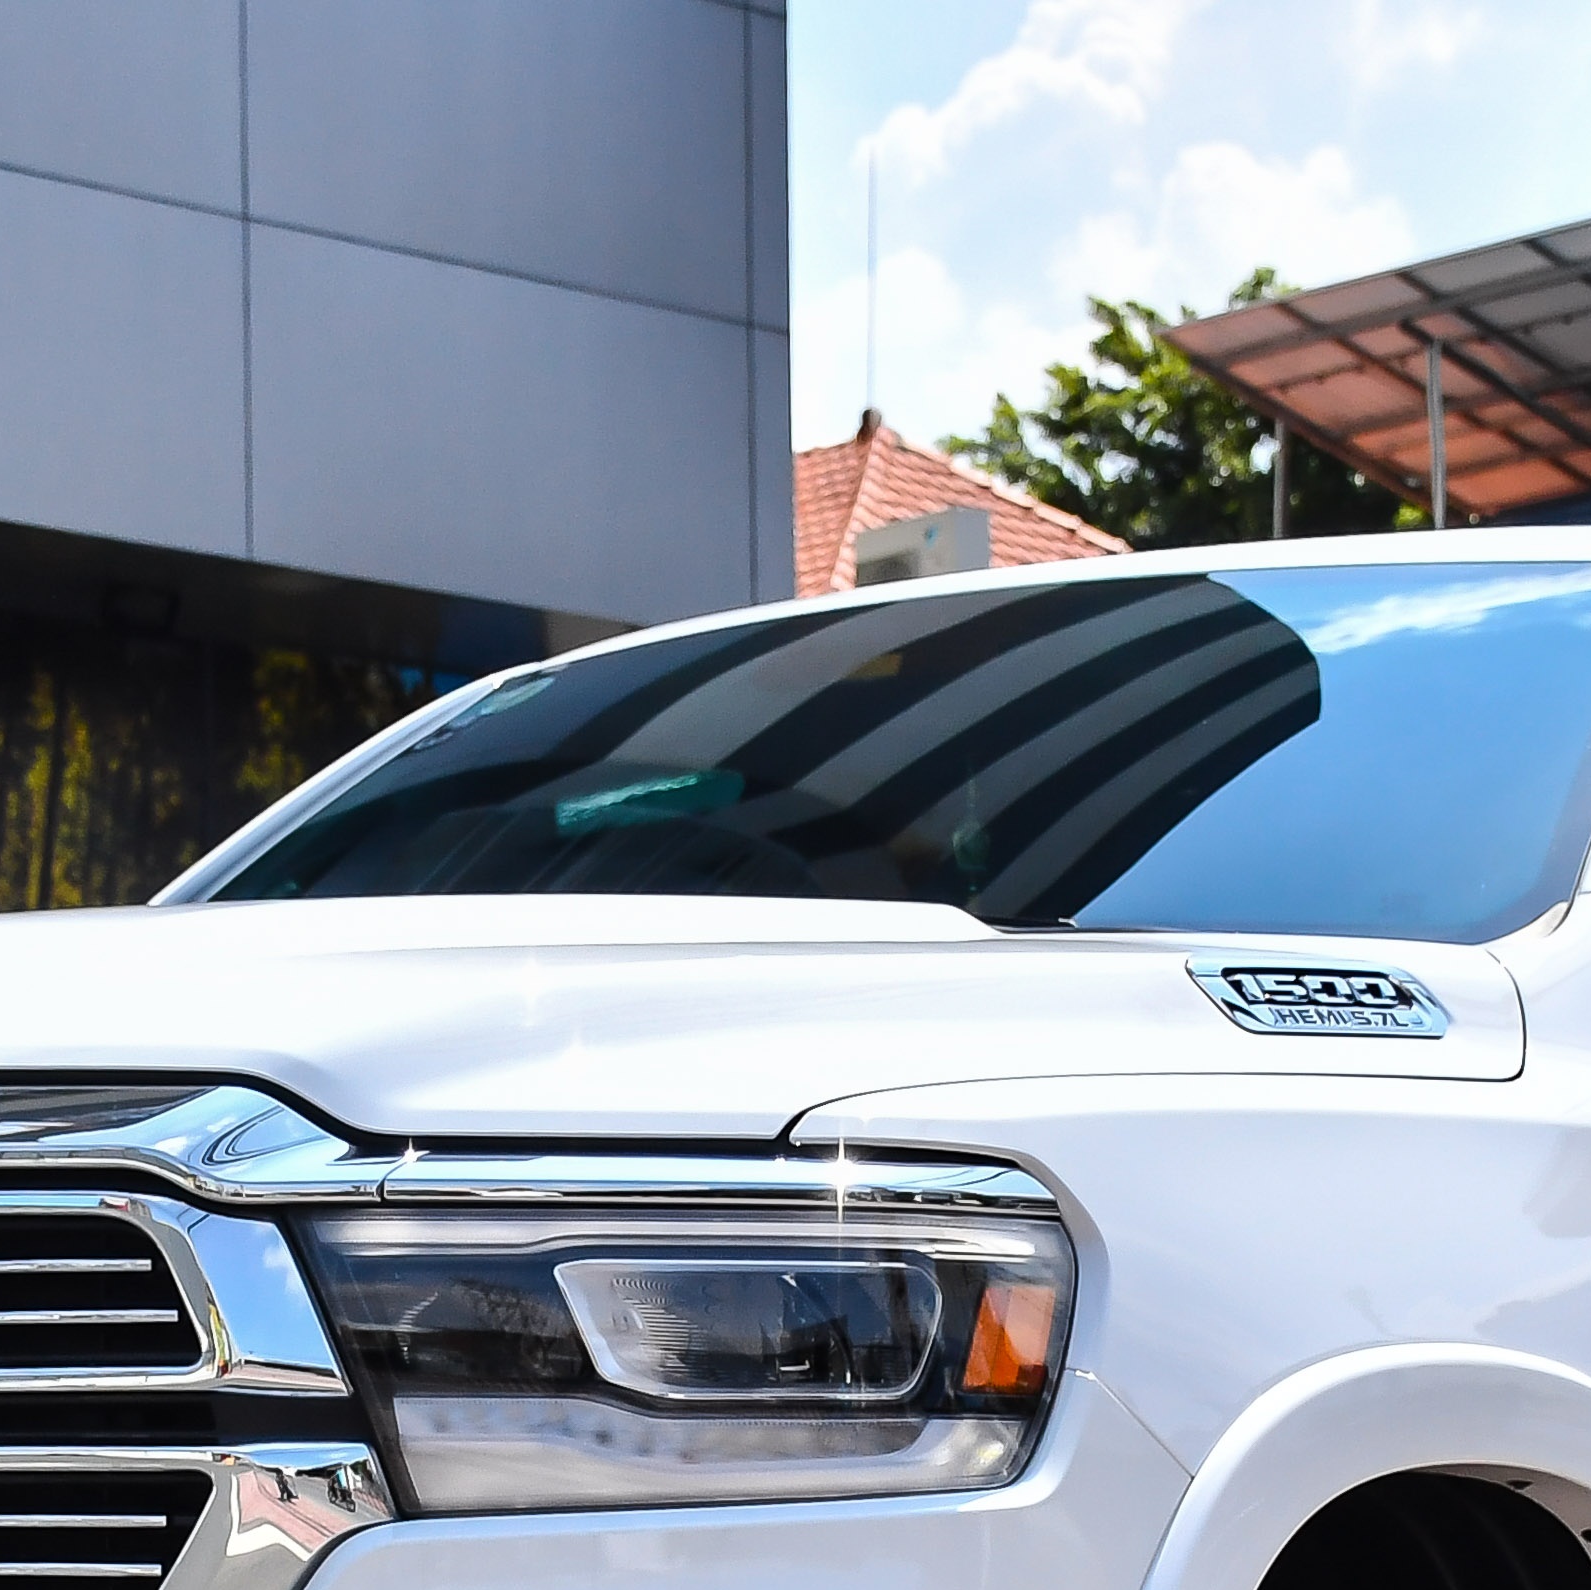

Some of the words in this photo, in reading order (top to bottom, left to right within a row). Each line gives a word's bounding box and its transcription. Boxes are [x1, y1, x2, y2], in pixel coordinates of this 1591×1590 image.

[1230, 973, 1404, 1007] 1500
[1276, 1006, 1349, 1026] HEMI
[1350, 1008, 1410, 1027] 5.7L
